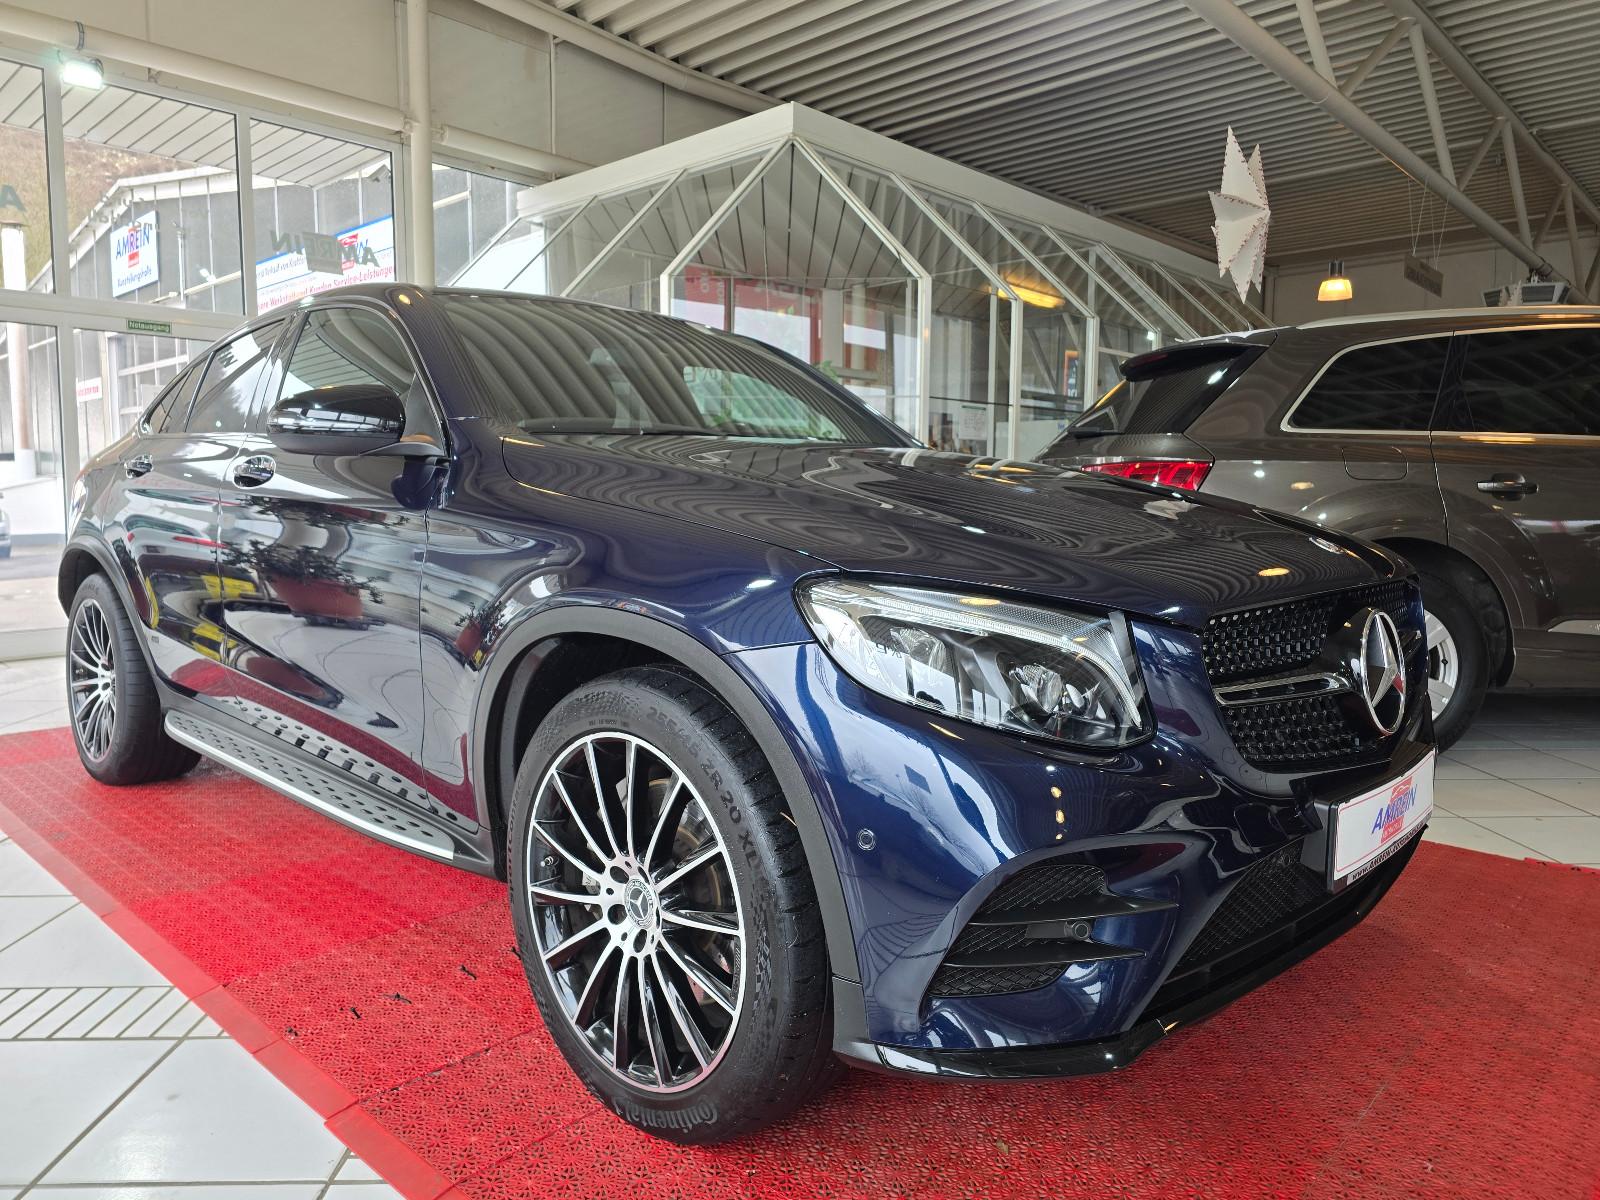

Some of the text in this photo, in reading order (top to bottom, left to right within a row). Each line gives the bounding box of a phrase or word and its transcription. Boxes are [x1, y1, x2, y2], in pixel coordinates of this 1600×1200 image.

[115, 224, 151, 260] AMREIN
[334, 265, 393, 288] Service-Leistunge
[1371, 783, 1418, 835] AMREIN
[624, 1098, 718, 1134] Continental
